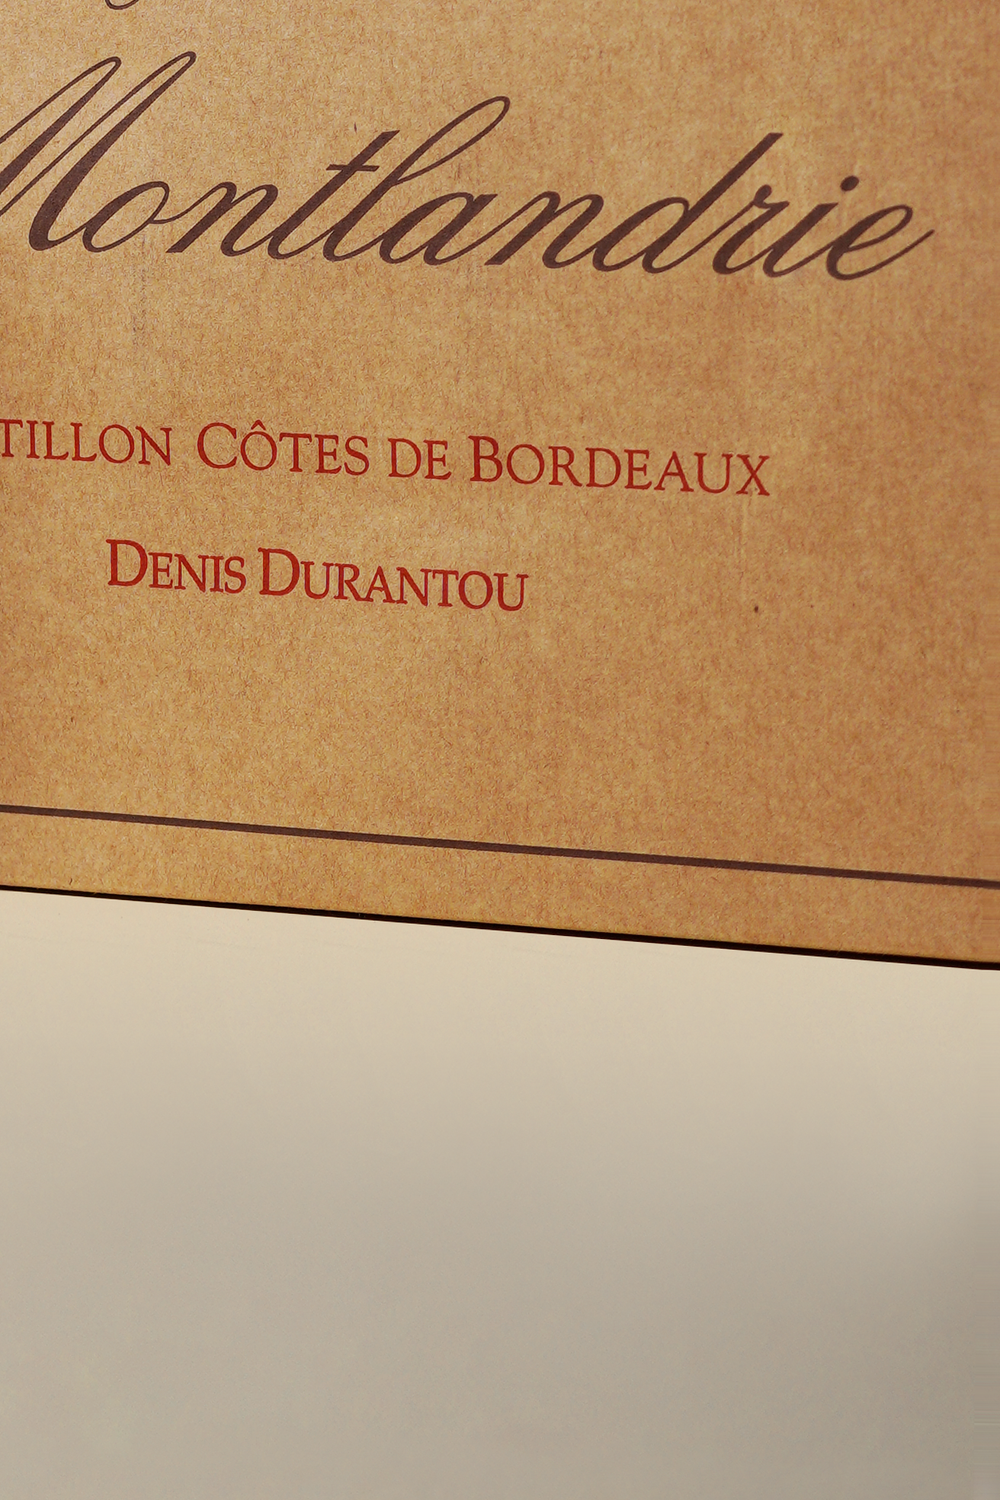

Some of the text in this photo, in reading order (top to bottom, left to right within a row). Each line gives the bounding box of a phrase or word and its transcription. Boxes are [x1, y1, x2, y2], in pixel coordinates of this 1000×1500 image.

[197, 419, 371, 478] CÔTES
[387, 436, 452, 482] DE
[468, 434, 771, 498] BORDEAUX
[105, 538, 530, 613] DENIS DURANTOU
